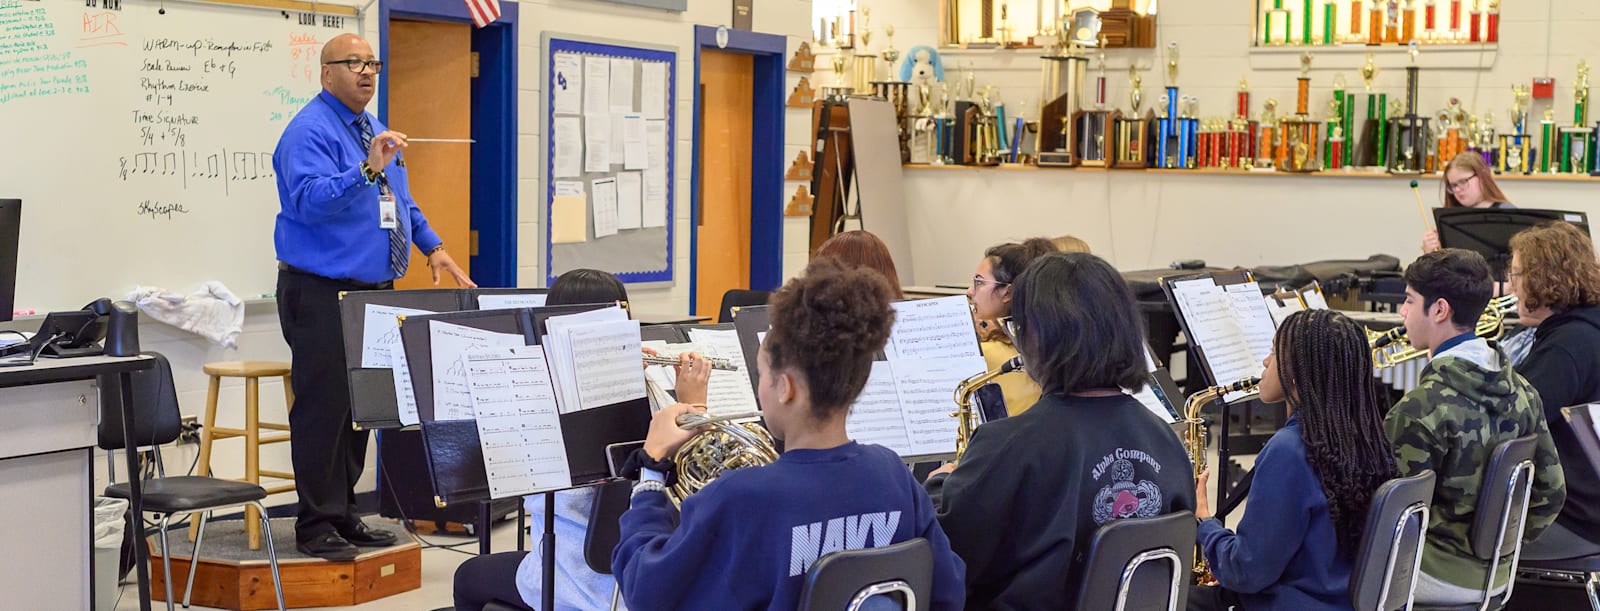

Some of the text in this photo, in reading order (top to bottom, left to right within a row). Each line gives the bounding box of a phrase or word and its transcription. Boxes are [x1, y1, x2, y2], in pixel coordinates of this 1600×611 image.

[298, 12, 345, 29] LOOK HERE!
[140, 77, 176, 95] Rhythm
[1092, 447, 1161, 480] Alpha Company
[789, 510, 902, 577] NAVY
